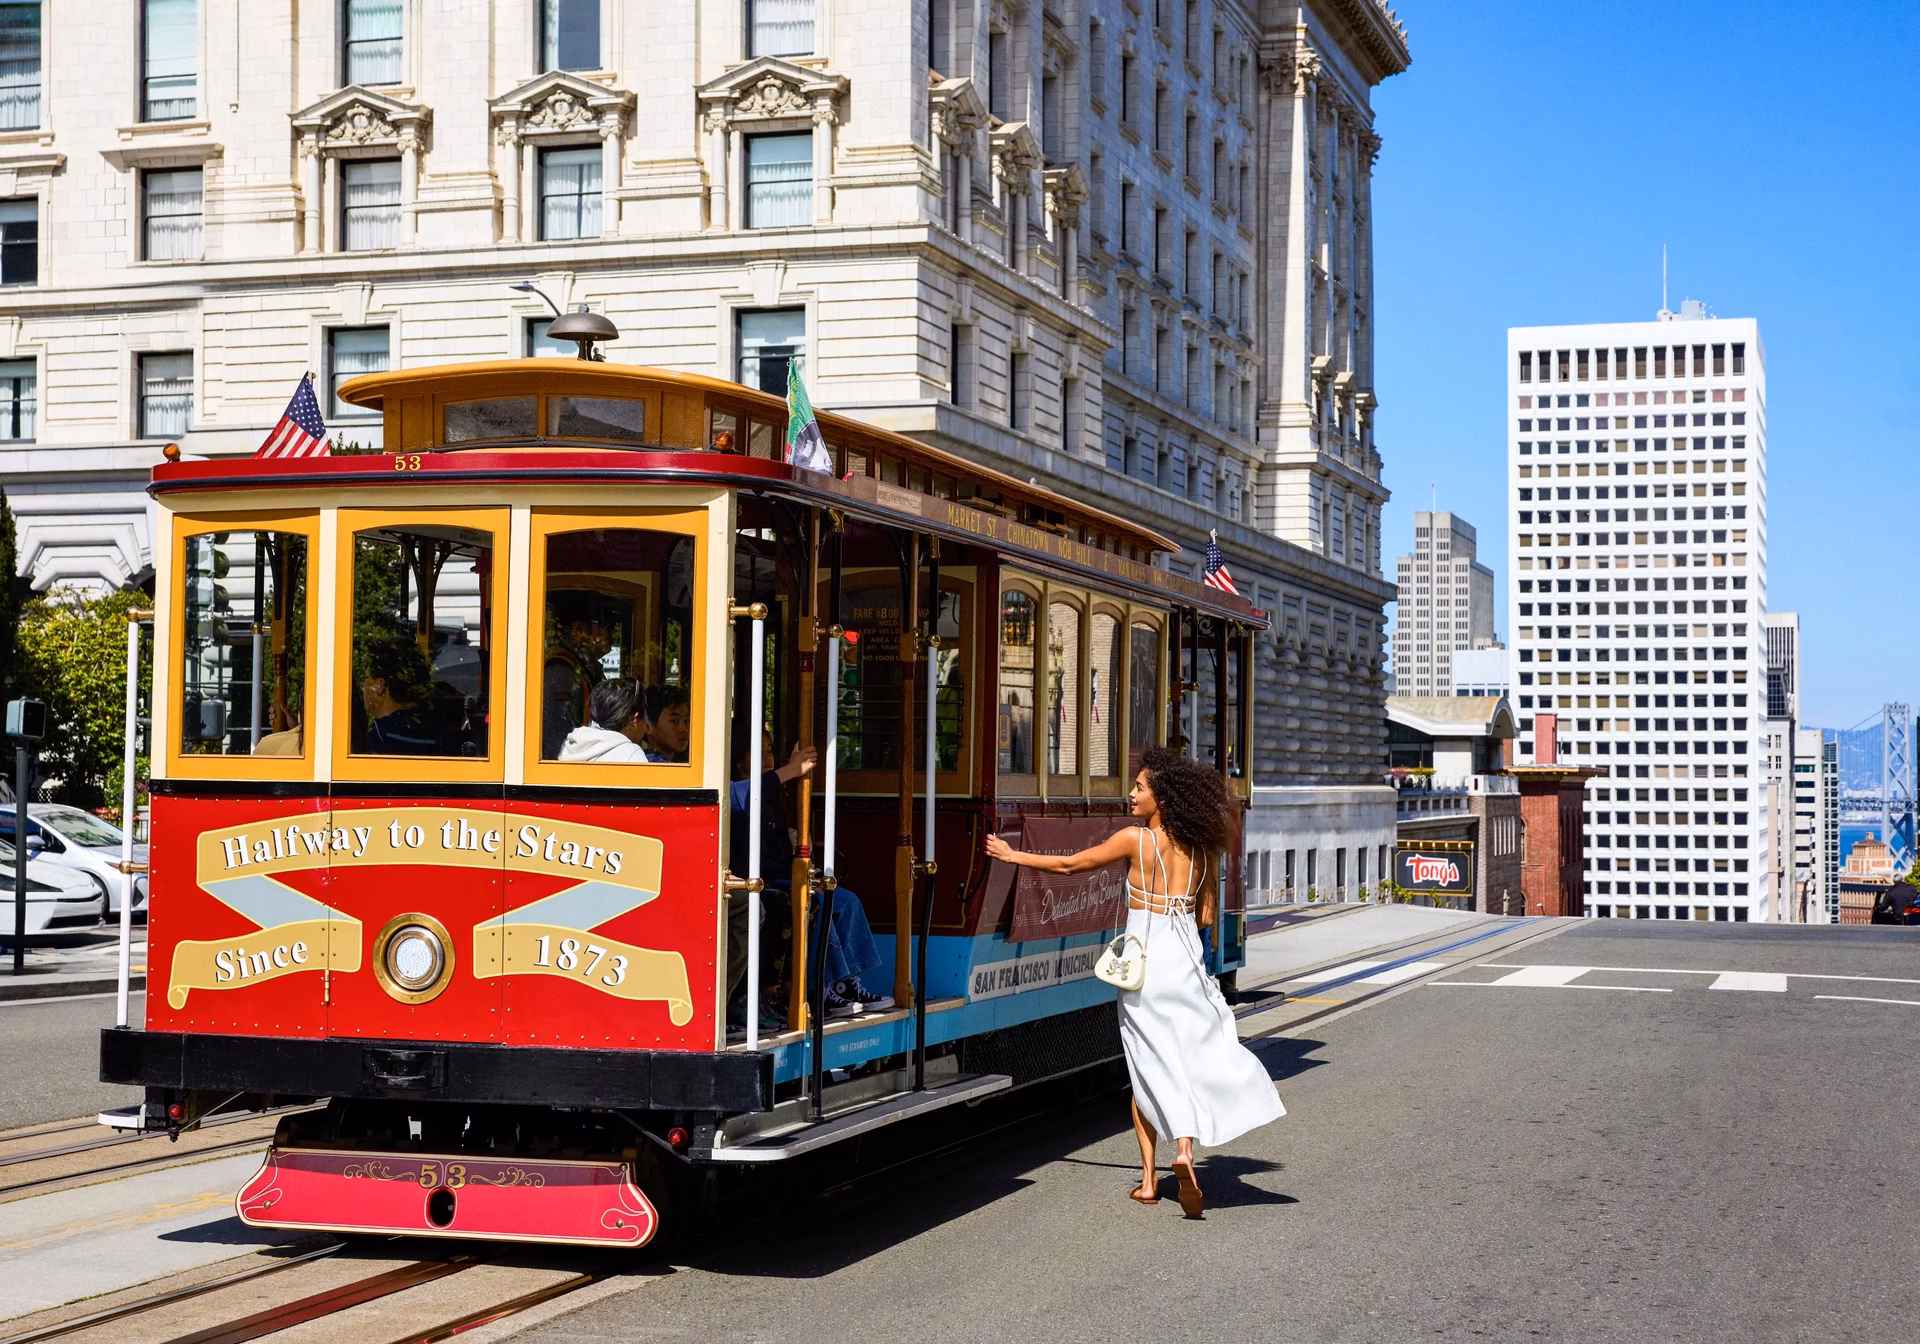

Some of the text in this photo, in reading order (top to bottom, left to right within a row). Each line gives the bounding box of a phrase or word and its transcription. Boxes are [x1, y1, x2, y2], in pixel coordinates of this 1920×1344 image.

[394, 455, 421, 472] 53
[947, 504, 981, 534] MARKET
[1007, 523, 1049, 552] CHINATOWN
[1058, 539, 1072, 561] NOB
[1076, 546, 1091, 567] HILL
[1104, 558, 1109, 572] &
[1118, 559, 1131, 577] VAN
[1131, 563, 1146, 583] NESS
[853, 608, 873, 619] FARE
[875, 607, 899, 619] $8.00
[220, 818, 625, 875] Halfway to the Stars
[1406, 854, 1459, 887] Tonga
[1040, 884, 1083, 925] Dedicated
[1080, 888, 1087, 911] to
[1087, 875, 1099, 916] Tony
[214, 934, 629, 988] Since 1873
[974, 970, 996, 995] SAN
[839, 1045, 849, 1053] TWO
[869, 1037, 880, 1047] ONLY
[417, 1163, 468, 1189] 53
